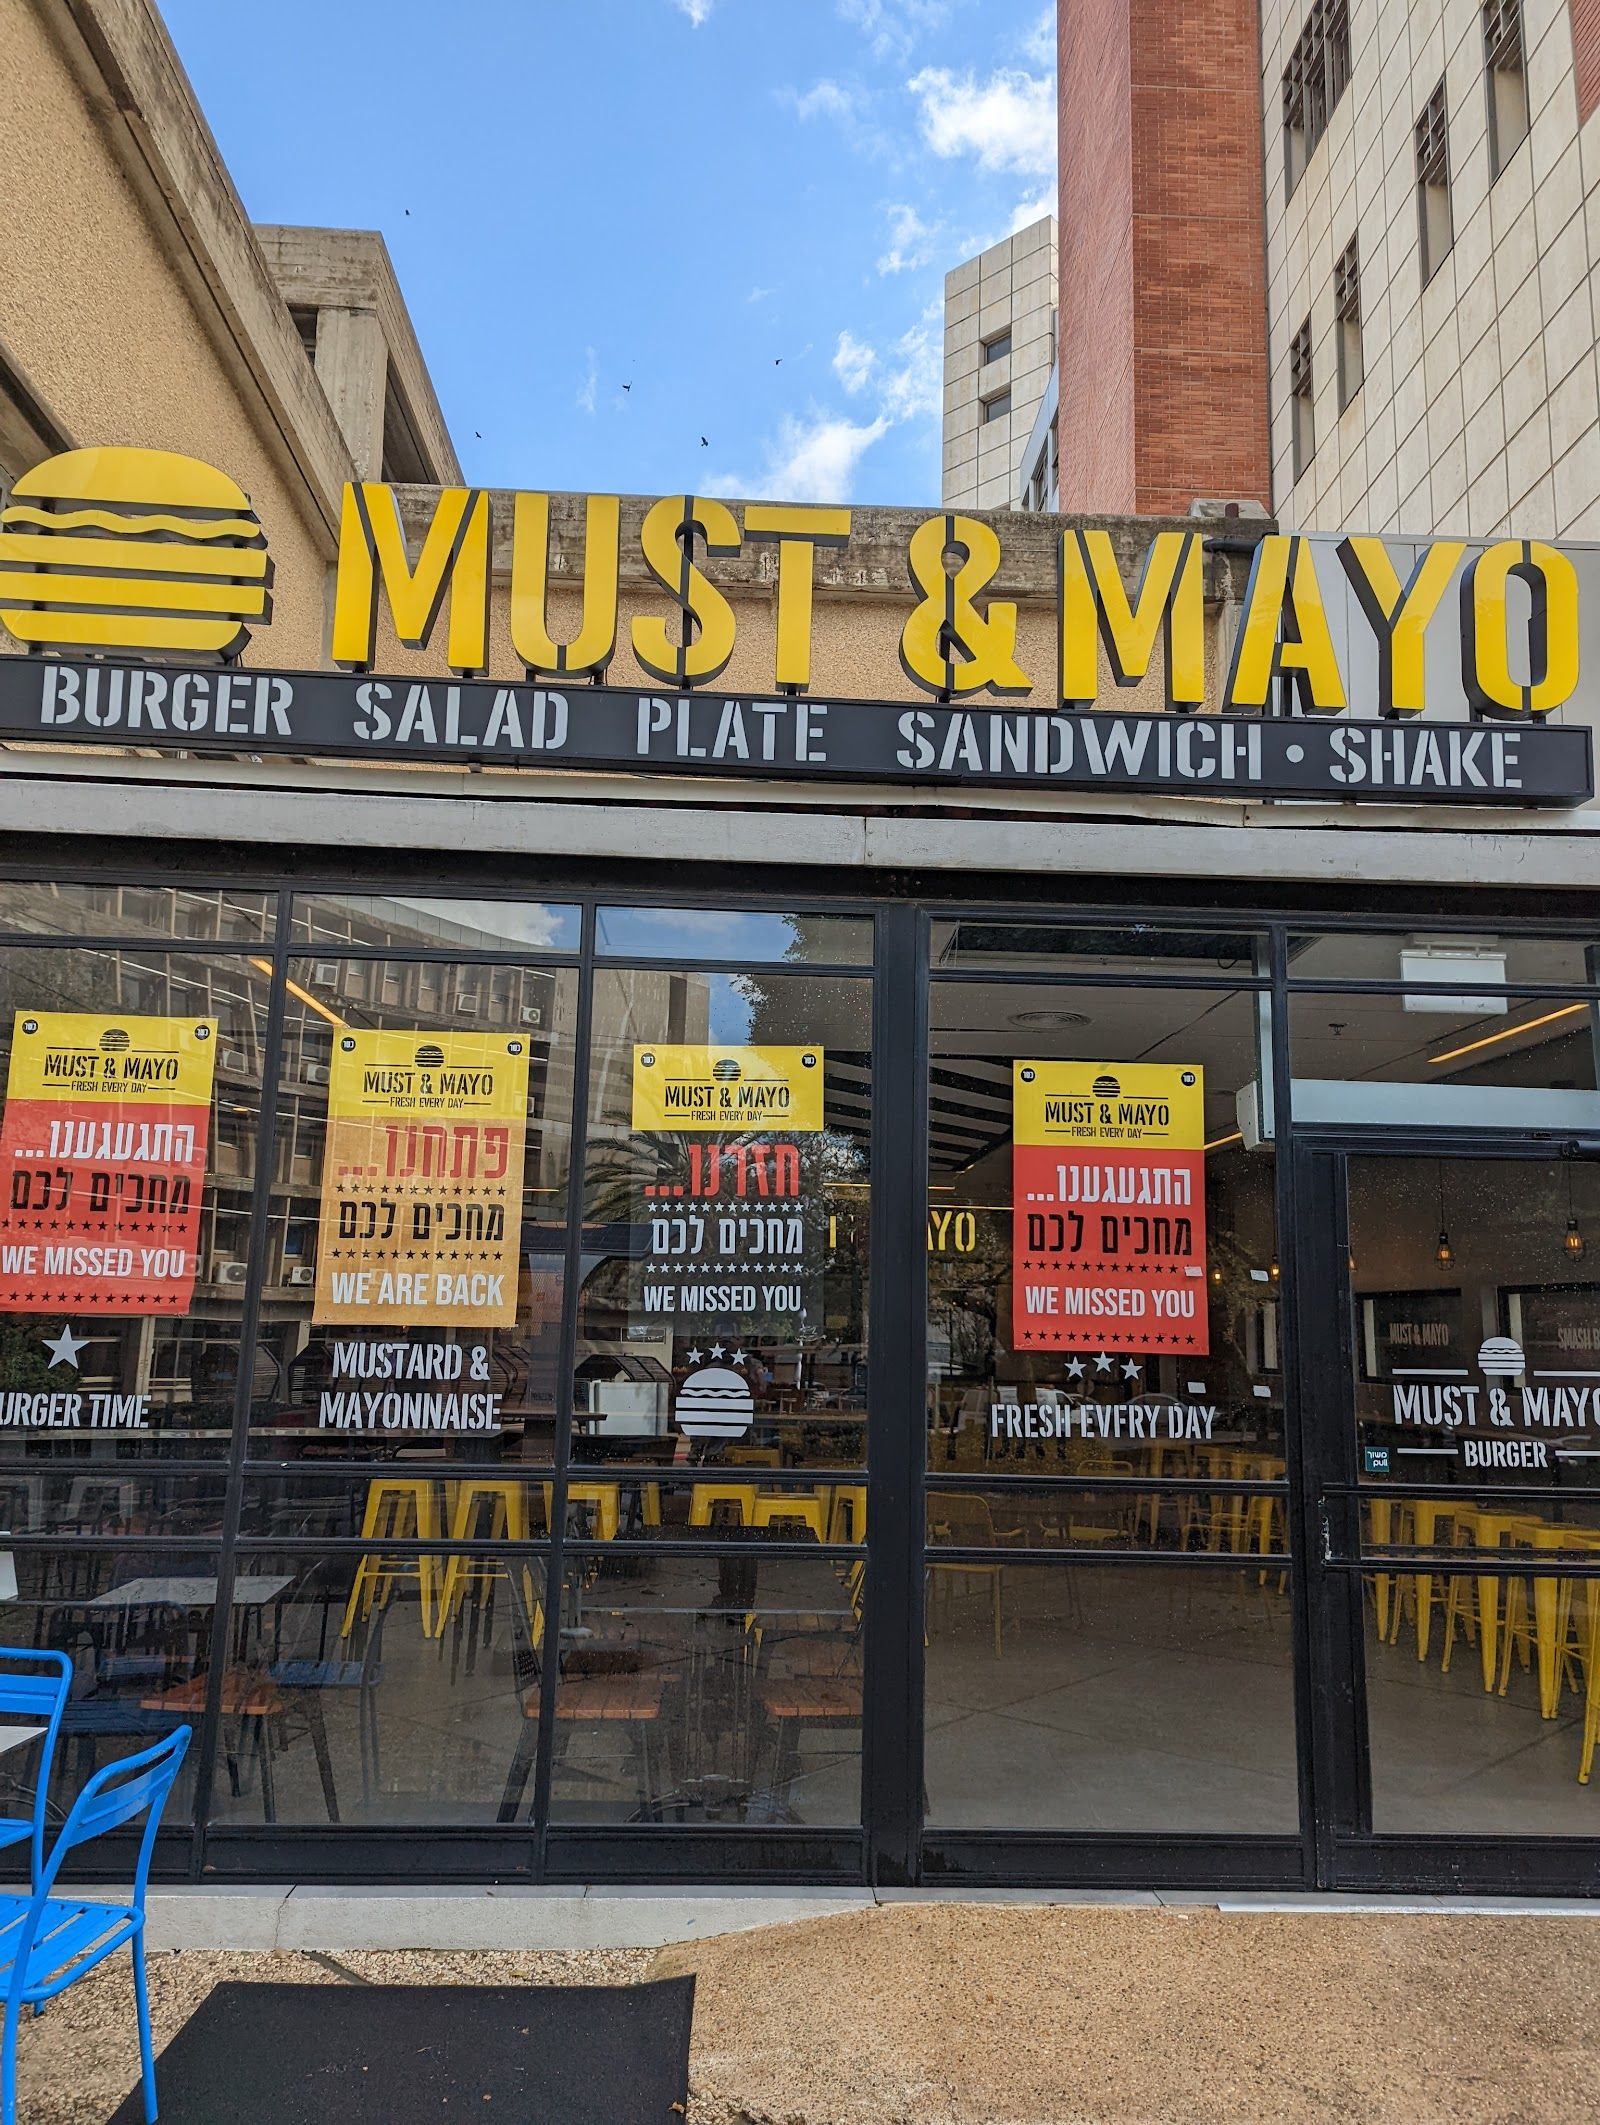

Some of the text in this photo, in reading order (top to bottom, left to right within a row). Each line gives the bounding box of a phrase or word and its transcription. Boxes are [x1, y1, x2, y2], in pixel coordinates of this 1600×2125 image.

[333, 481, 1579, 718] MUST & MAYO
[41, 666, 1522, 789] BURGER SALAD PLATE SANDWICH SHAKE
[44, 1054, 179, 1080] MUST & MAYO
[363, 1071, 493, 1096] MUST & MAYO
[71, 1081, 148, 1093] FRESH EVERY DAY
[390, 1097, 464, 1108] FRESH EVERY DAY
[665, 1086, 790, 1108] MUST & MAYO
[691, 1110, 763, 1121] FRESH EVERY DAY
[1045, 1102, 1169, 1126] MUST & MAYO
[15, 1120, 195, 1162] התגעגענו...
[1071, 1127, 1143, 1138] FRESH EVERY DAY
[338, 1125, 509, 1179] פתחנו...
[644, 1144, 800, 1196] חזרנו...
[1027, 1165, 1191, 1205] התגעגענו...
[11, 1167, 191, 1214] מחכים לכם
[339, 1198, 505, 1241] מחכים לכם
[651, 1214, 705, 1254] לכם
[719, 1218, 803, 1254] מחכים
[928, 1211, 976, 1251] YO
[1027, 1210, 1192, 1255] מחכים לכם
[2, 1246, 185, 1278] WE MISSED YOU
[331, 1272, 504, 1306] WE ARE BACK
[643, 1285, 801, 1312] WE MISSED YOU
[1025, 1286, 1195, 1317] WE MISSED YOU
[332, 1341, 490, 1380] MUSTARD &
[88, 1394, 152, 1428] TIME
[319, 1392, 503, 1430] MAYONNAISE
[991, 1404, 1070, 1438] FRESH
[1168, 1405, 1216, 1439] DAY
[1393, 1385, 1479, 1426] MUST
[1489, 1388, 1514, 1426] &
[1373, 1459, 1388, 1467] pull
[1464, 1441, 1548, 1468] BURGER
